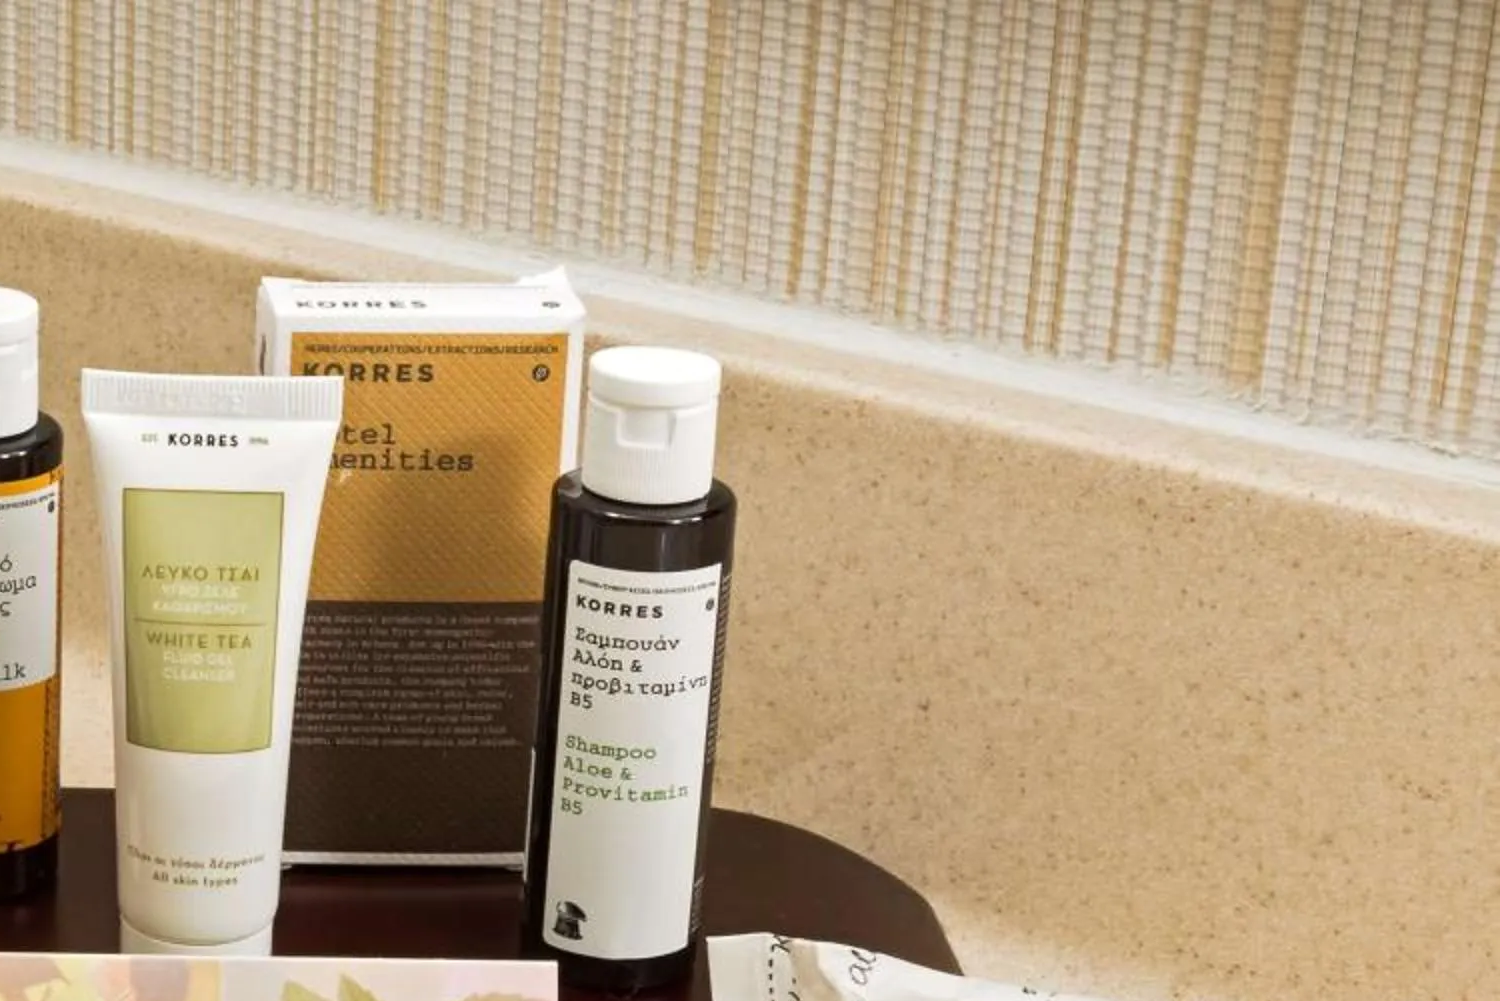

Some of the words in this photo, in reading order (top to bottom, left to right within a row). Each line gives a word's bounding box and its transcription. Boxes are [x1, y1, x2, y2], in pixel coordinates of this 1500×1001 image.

[303, 363, 434, 383] KORRES
[167, 433, 239, 447] KORRES
[334, 424, 396, 446] tel
[141, 565, 209, 581] ΛΕΥΚΟ
[576, 595, 663, 619] KORRES
[147, 631, 209, 649] WHITE
[217, 634, 252, 649] TEA
[575, 627, 681, 651] Σαμπουάν
[572, 648, 624, 672] Αλόη
[630, 660, 643, 673] &
[571, 671, 708, 697] προβιταμίνη
[565, 735, 656, 761] Shampoo
[563, 756, 613, 779] Aloe
[620, 767, 634, 781] &
[562, 777, 688, 803] Provitamin
[560, 798, 583, 815] B5
